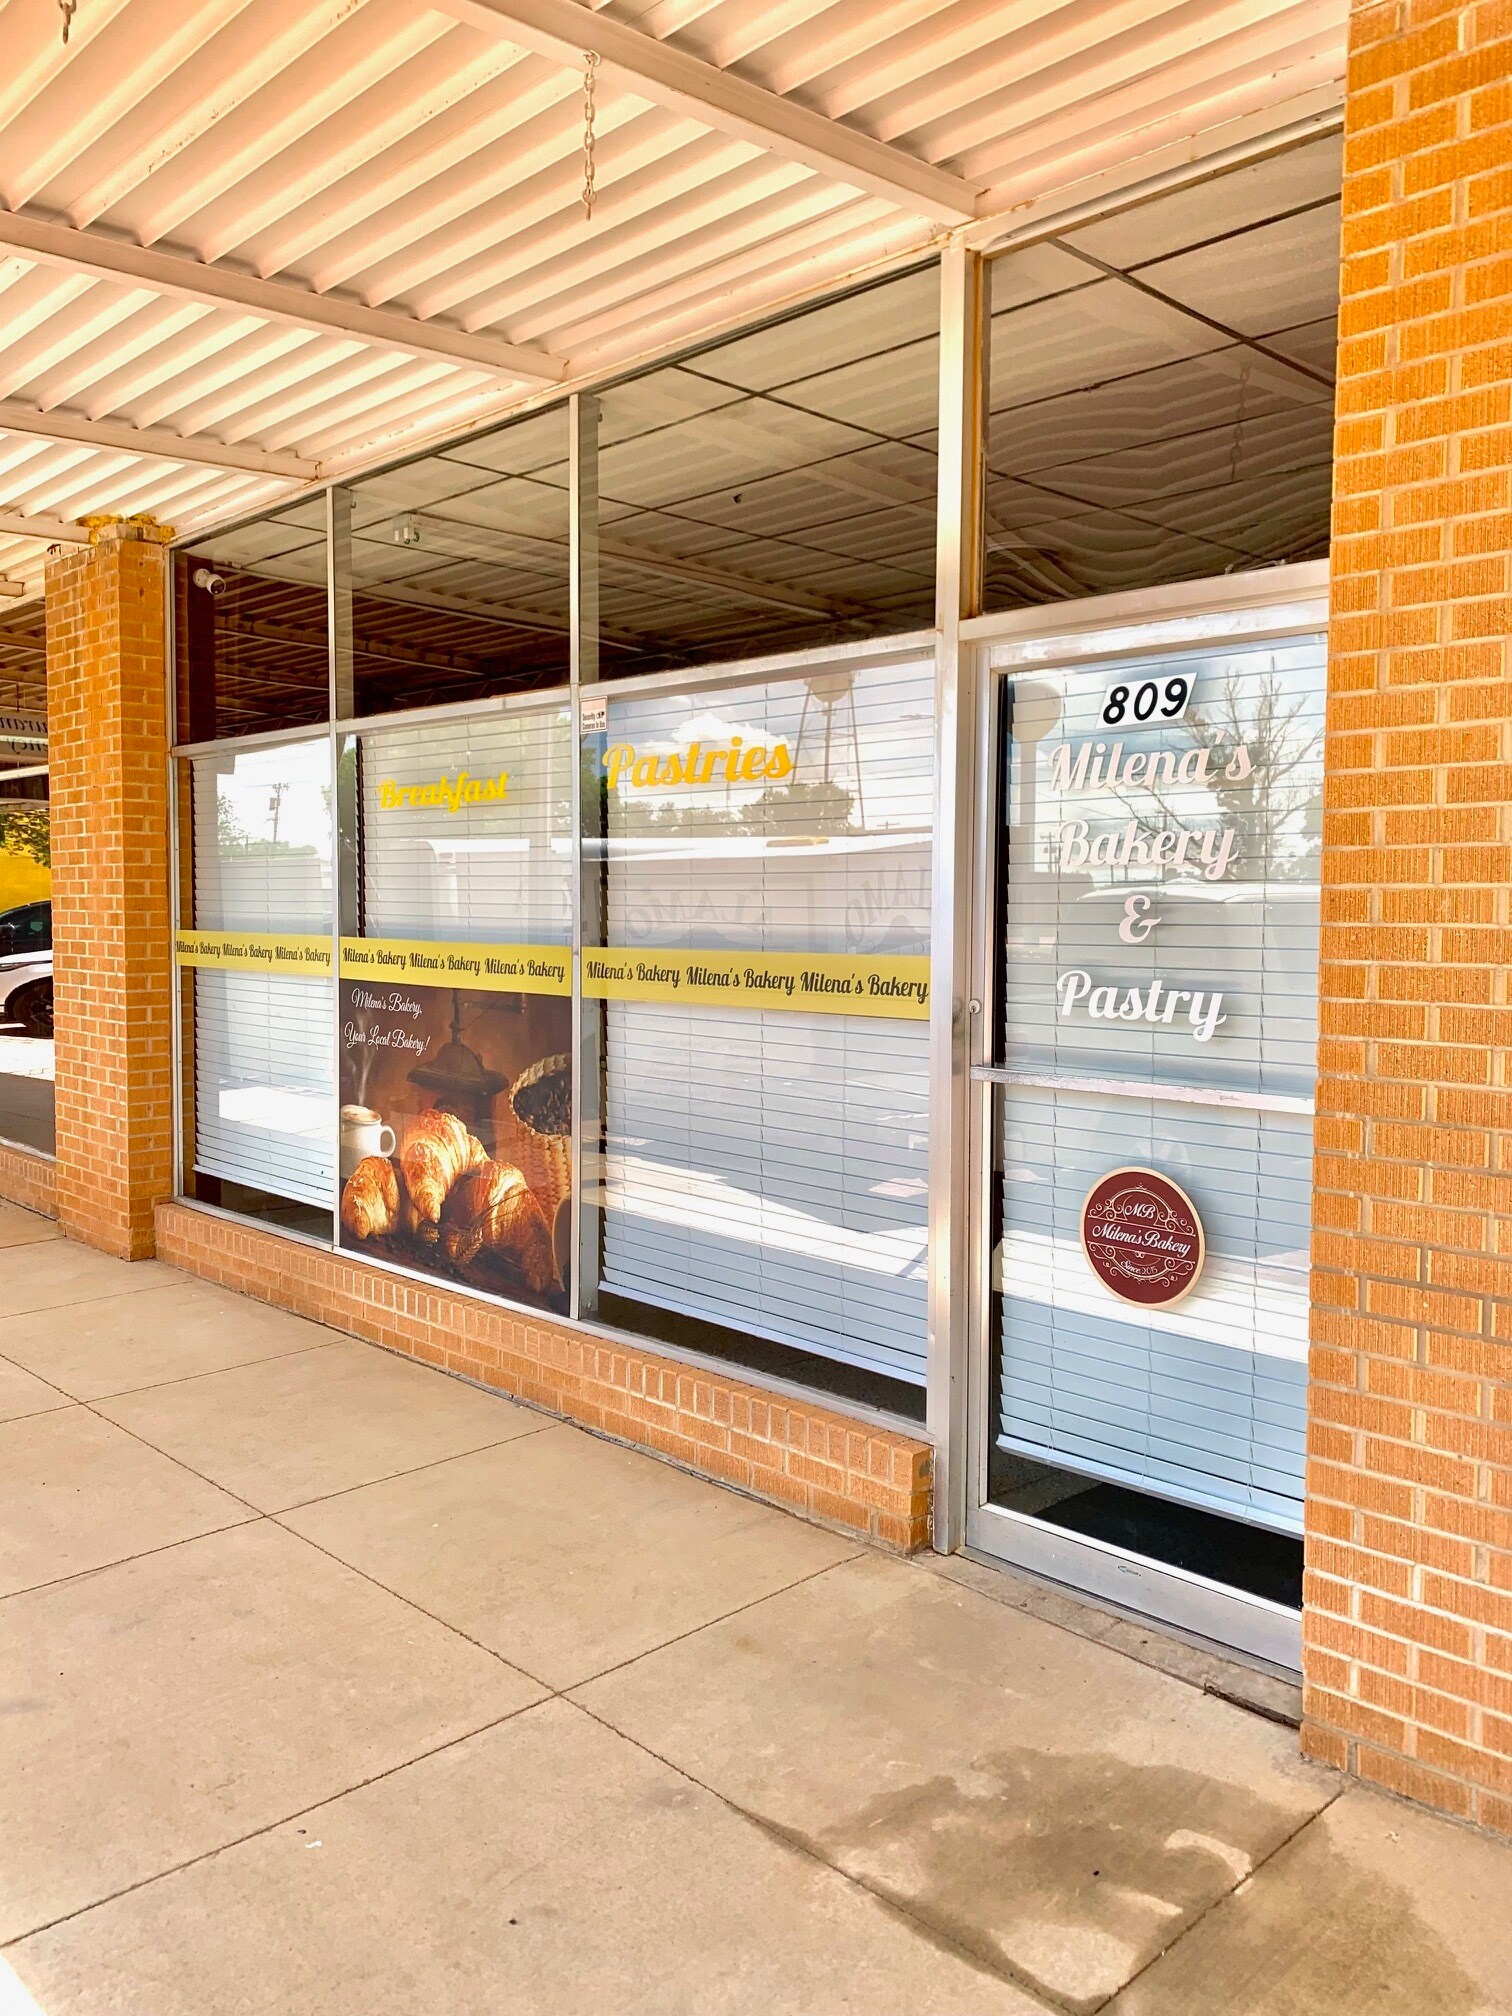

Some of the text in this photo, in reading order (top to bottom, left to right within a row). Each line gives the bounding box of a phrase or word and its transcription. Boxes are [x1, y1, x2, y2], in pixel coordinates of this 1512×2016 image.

[1102, 677, 1189, 726] 809
[602, 735, 795, 789] Pastries
[1047, 731, 1257, 791] Milena's
[377, 771, 510, 813] Breakfast
[1059, 818, 1240, 882] Bakery
[1117, 894, 1163, 944] &
[175, 940, 331, 967] Milena's Bakery Milena's Bakery Milena's Bakery
[342, 947, 566, 983] Milena's Bakery Milena's Bakery Milena's Bakery
[351, 987, 387, 1009] Milena's
[585, 961, 930, 1005] Milena's Bakery Milena's Bakery Milena's Bakery
[1056, 969, 1228, 1043] Pastry
[344, 1021, 431, 1056] Your Local Bakery!
[1124, 1202, 1156, 1219] MB
[1092, 1222, 1191, 1258] Milena's Bakery
[1120, 1260, 1140, 1275] Since
